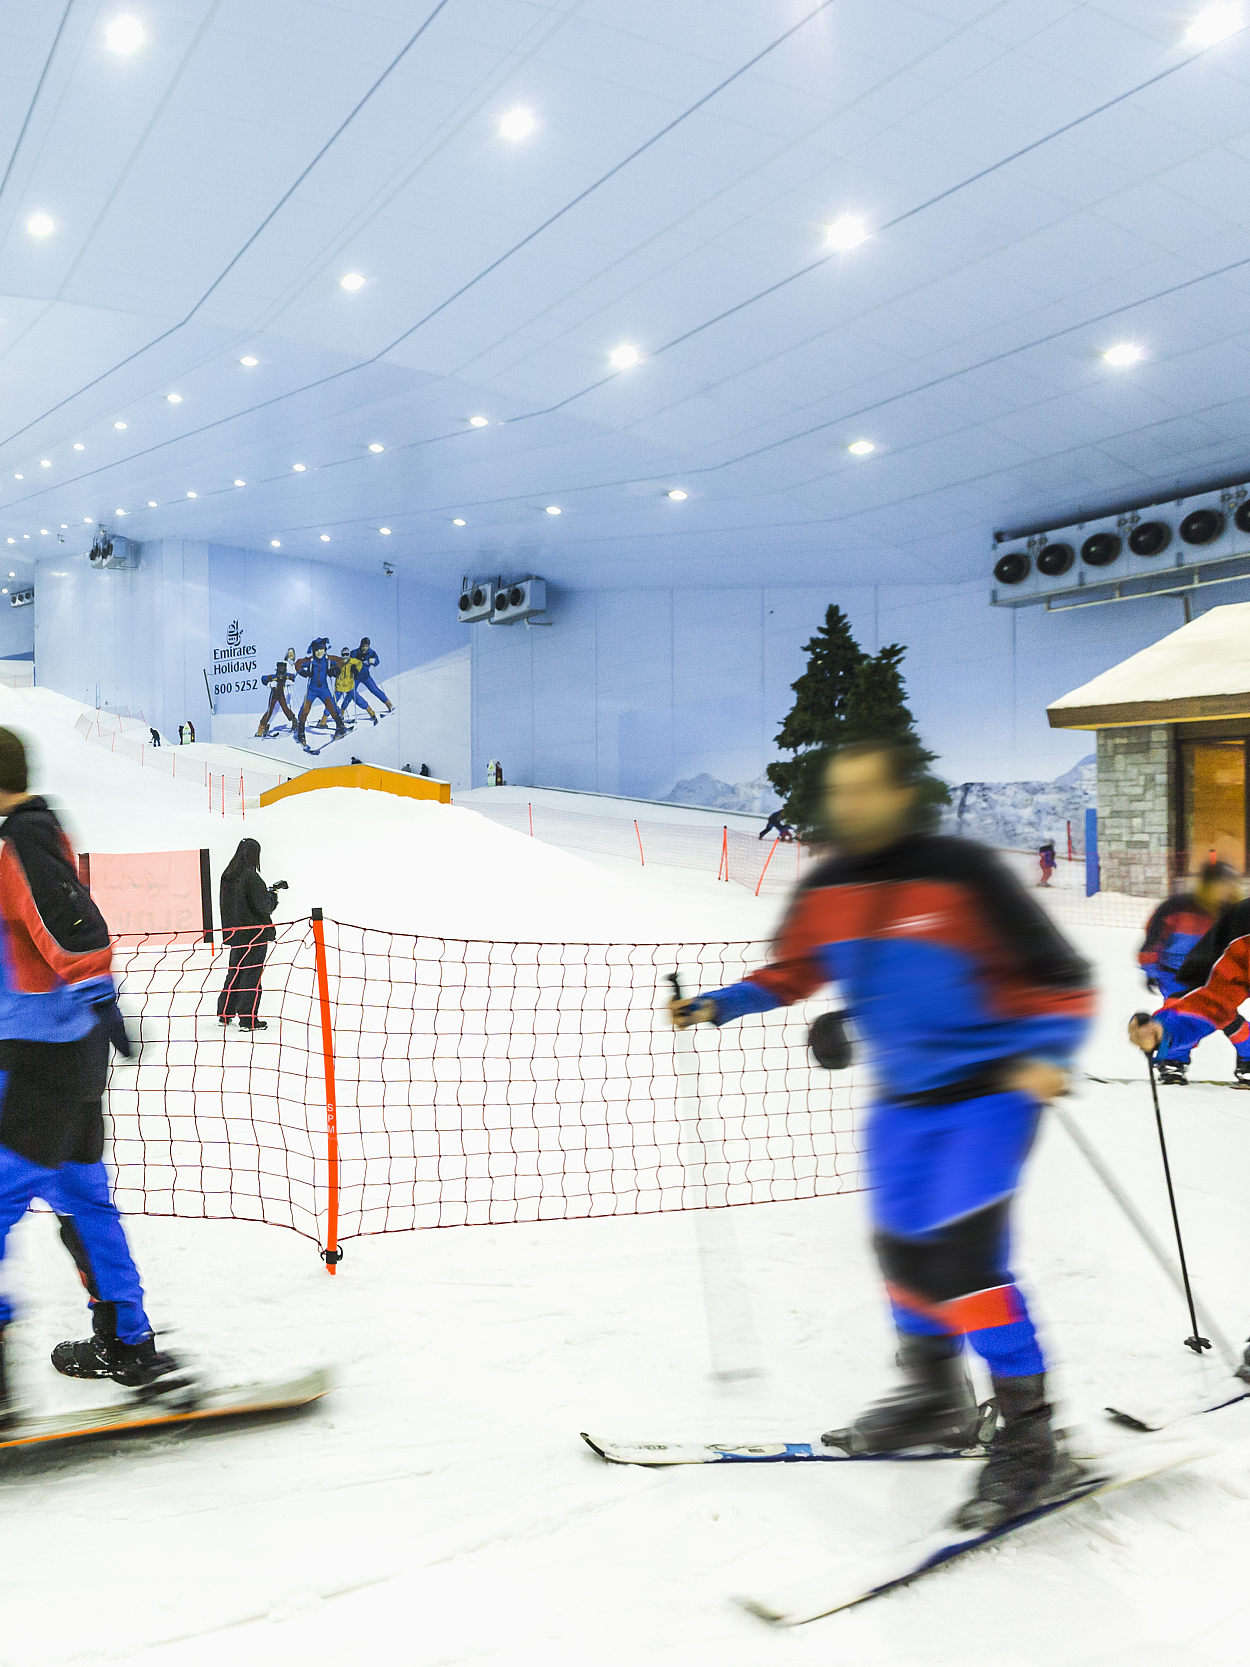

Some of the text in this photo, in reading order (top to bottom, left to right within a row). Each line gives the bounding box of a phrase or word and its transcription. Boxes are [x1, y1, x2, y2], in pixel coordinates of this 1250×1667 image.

[213, 645, 257, 660] Emirates
[213, 660, 257, 676] Holidays
[214, 679, 258, 695] 800 5252
